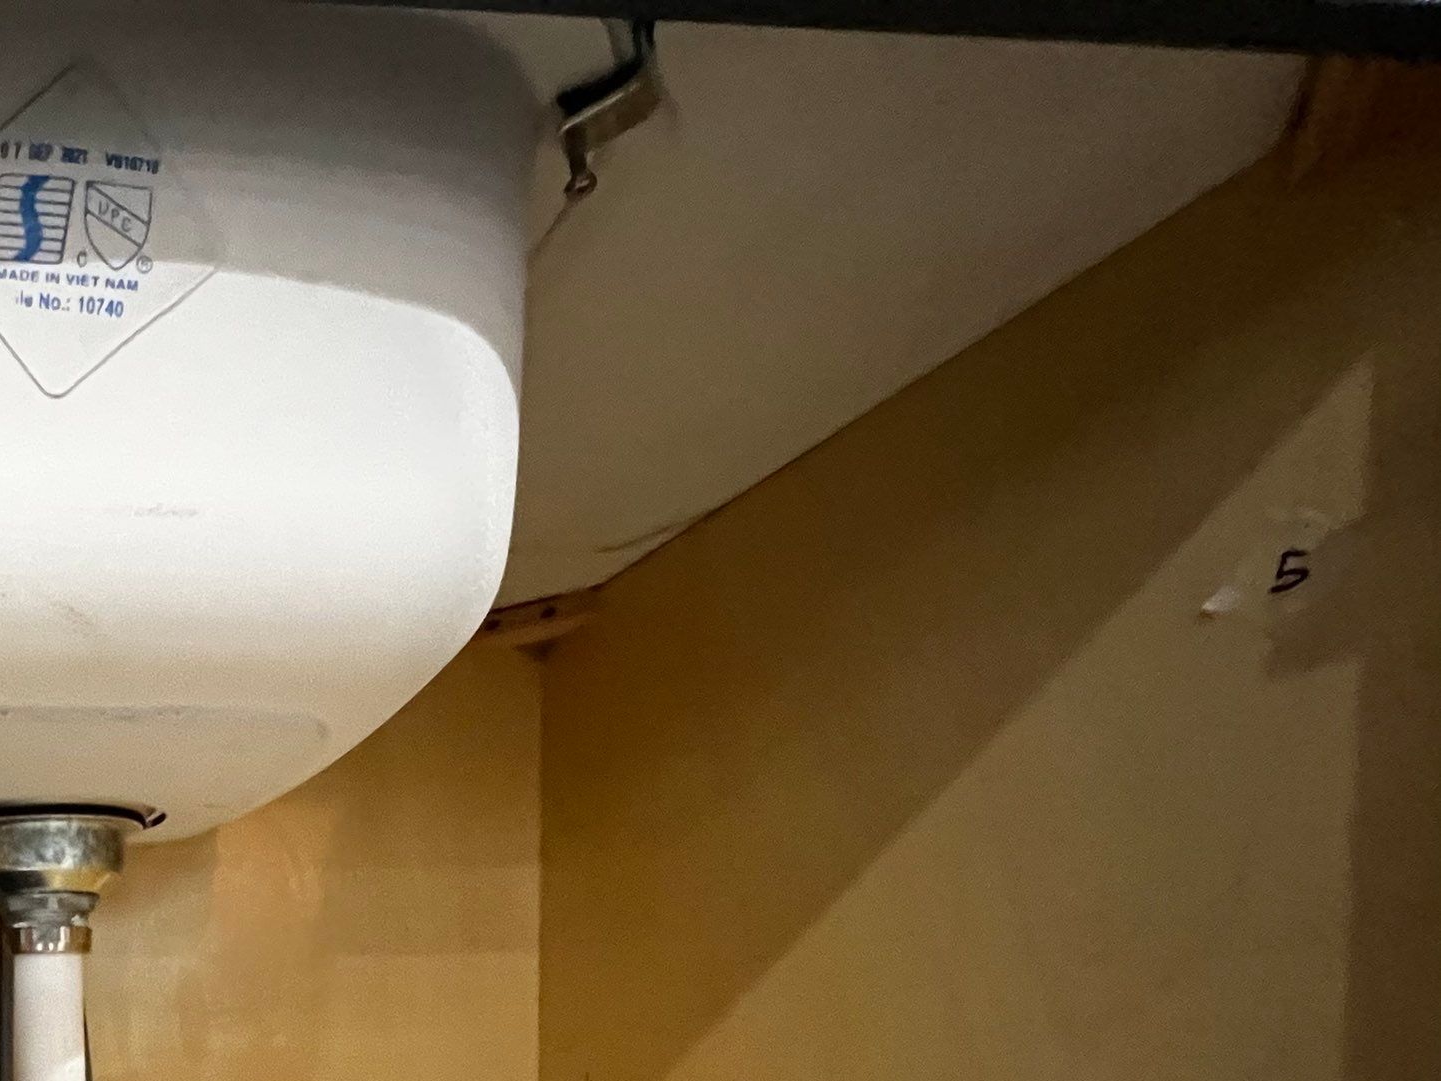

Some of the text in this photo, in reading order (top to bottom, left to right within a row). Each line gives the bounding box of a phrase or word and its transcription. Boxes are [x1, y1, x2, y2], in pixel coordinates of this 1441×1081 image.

[98, 200, 132, 233] UPC
[45, 272, 60, 284] IN
[66, 274, 100, 287] VIET
[105, 278, 138, 291] NAM
[79, 296, 124, 318] 10740
[1268, 549, 1309, 593] 5
